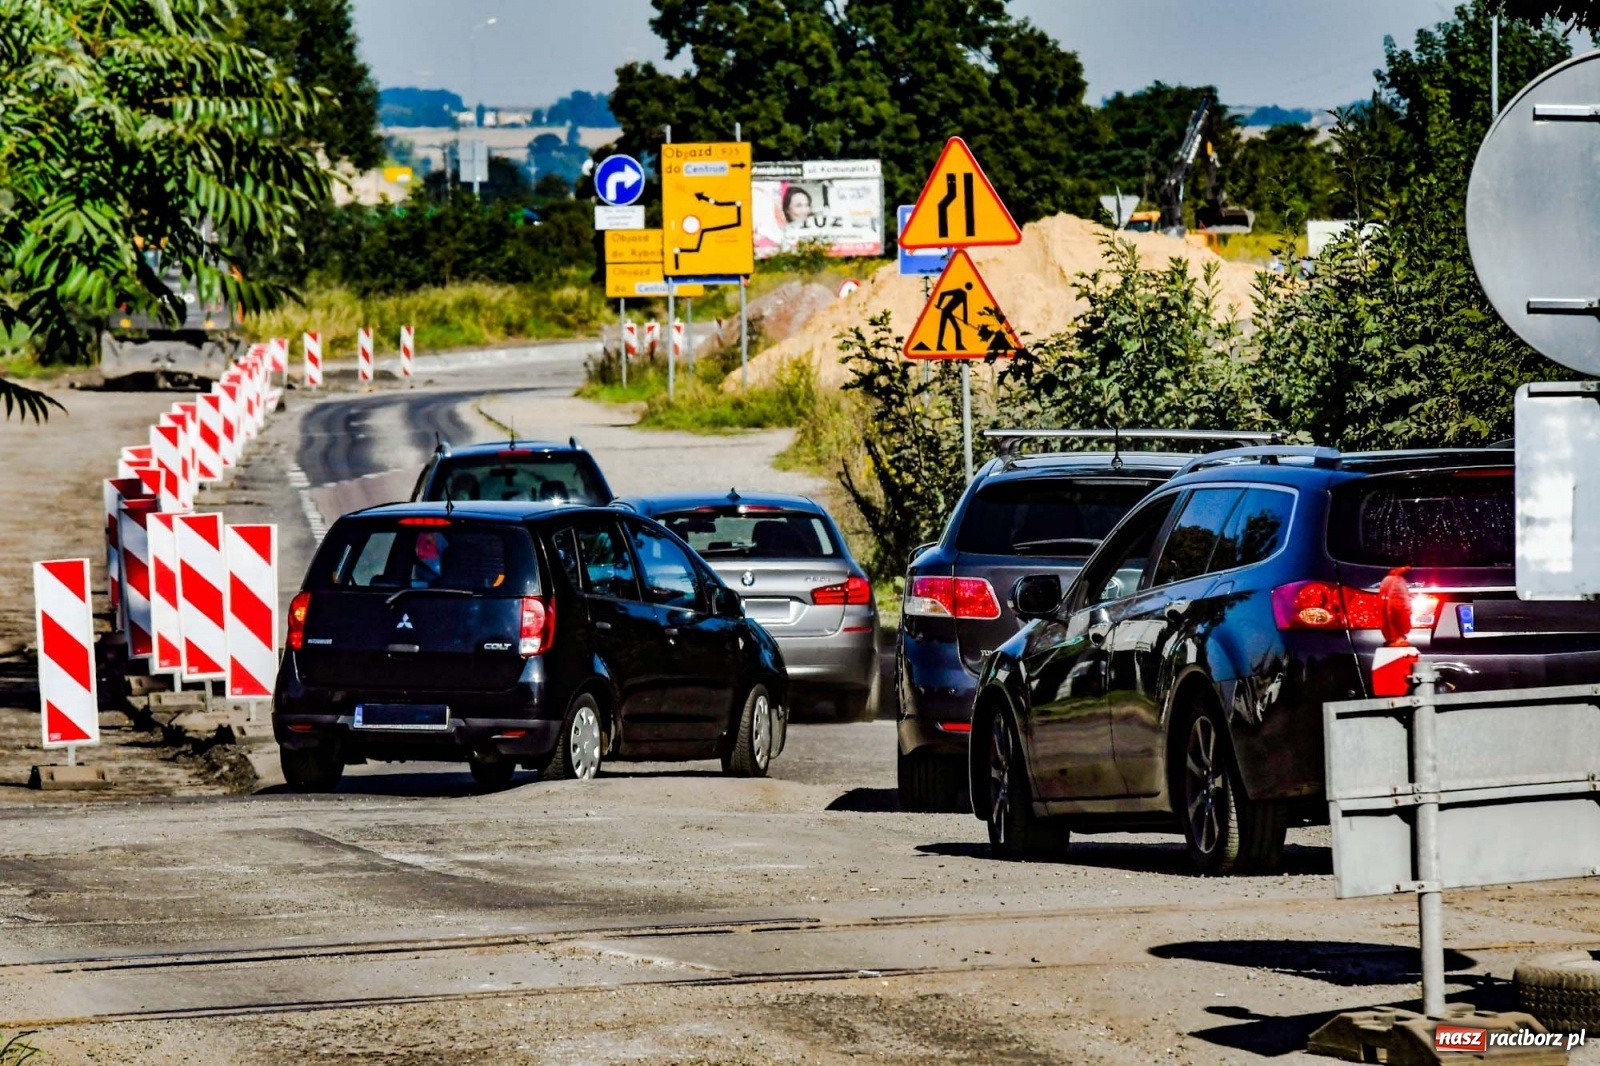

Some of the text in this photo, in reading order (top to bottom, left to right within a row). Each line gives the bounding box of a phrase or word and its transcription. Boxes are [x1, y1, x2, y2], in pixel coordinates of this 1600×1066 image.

[663, 145, 712, 160] Objazd
[665, 162, 727, 174] do Centrum
